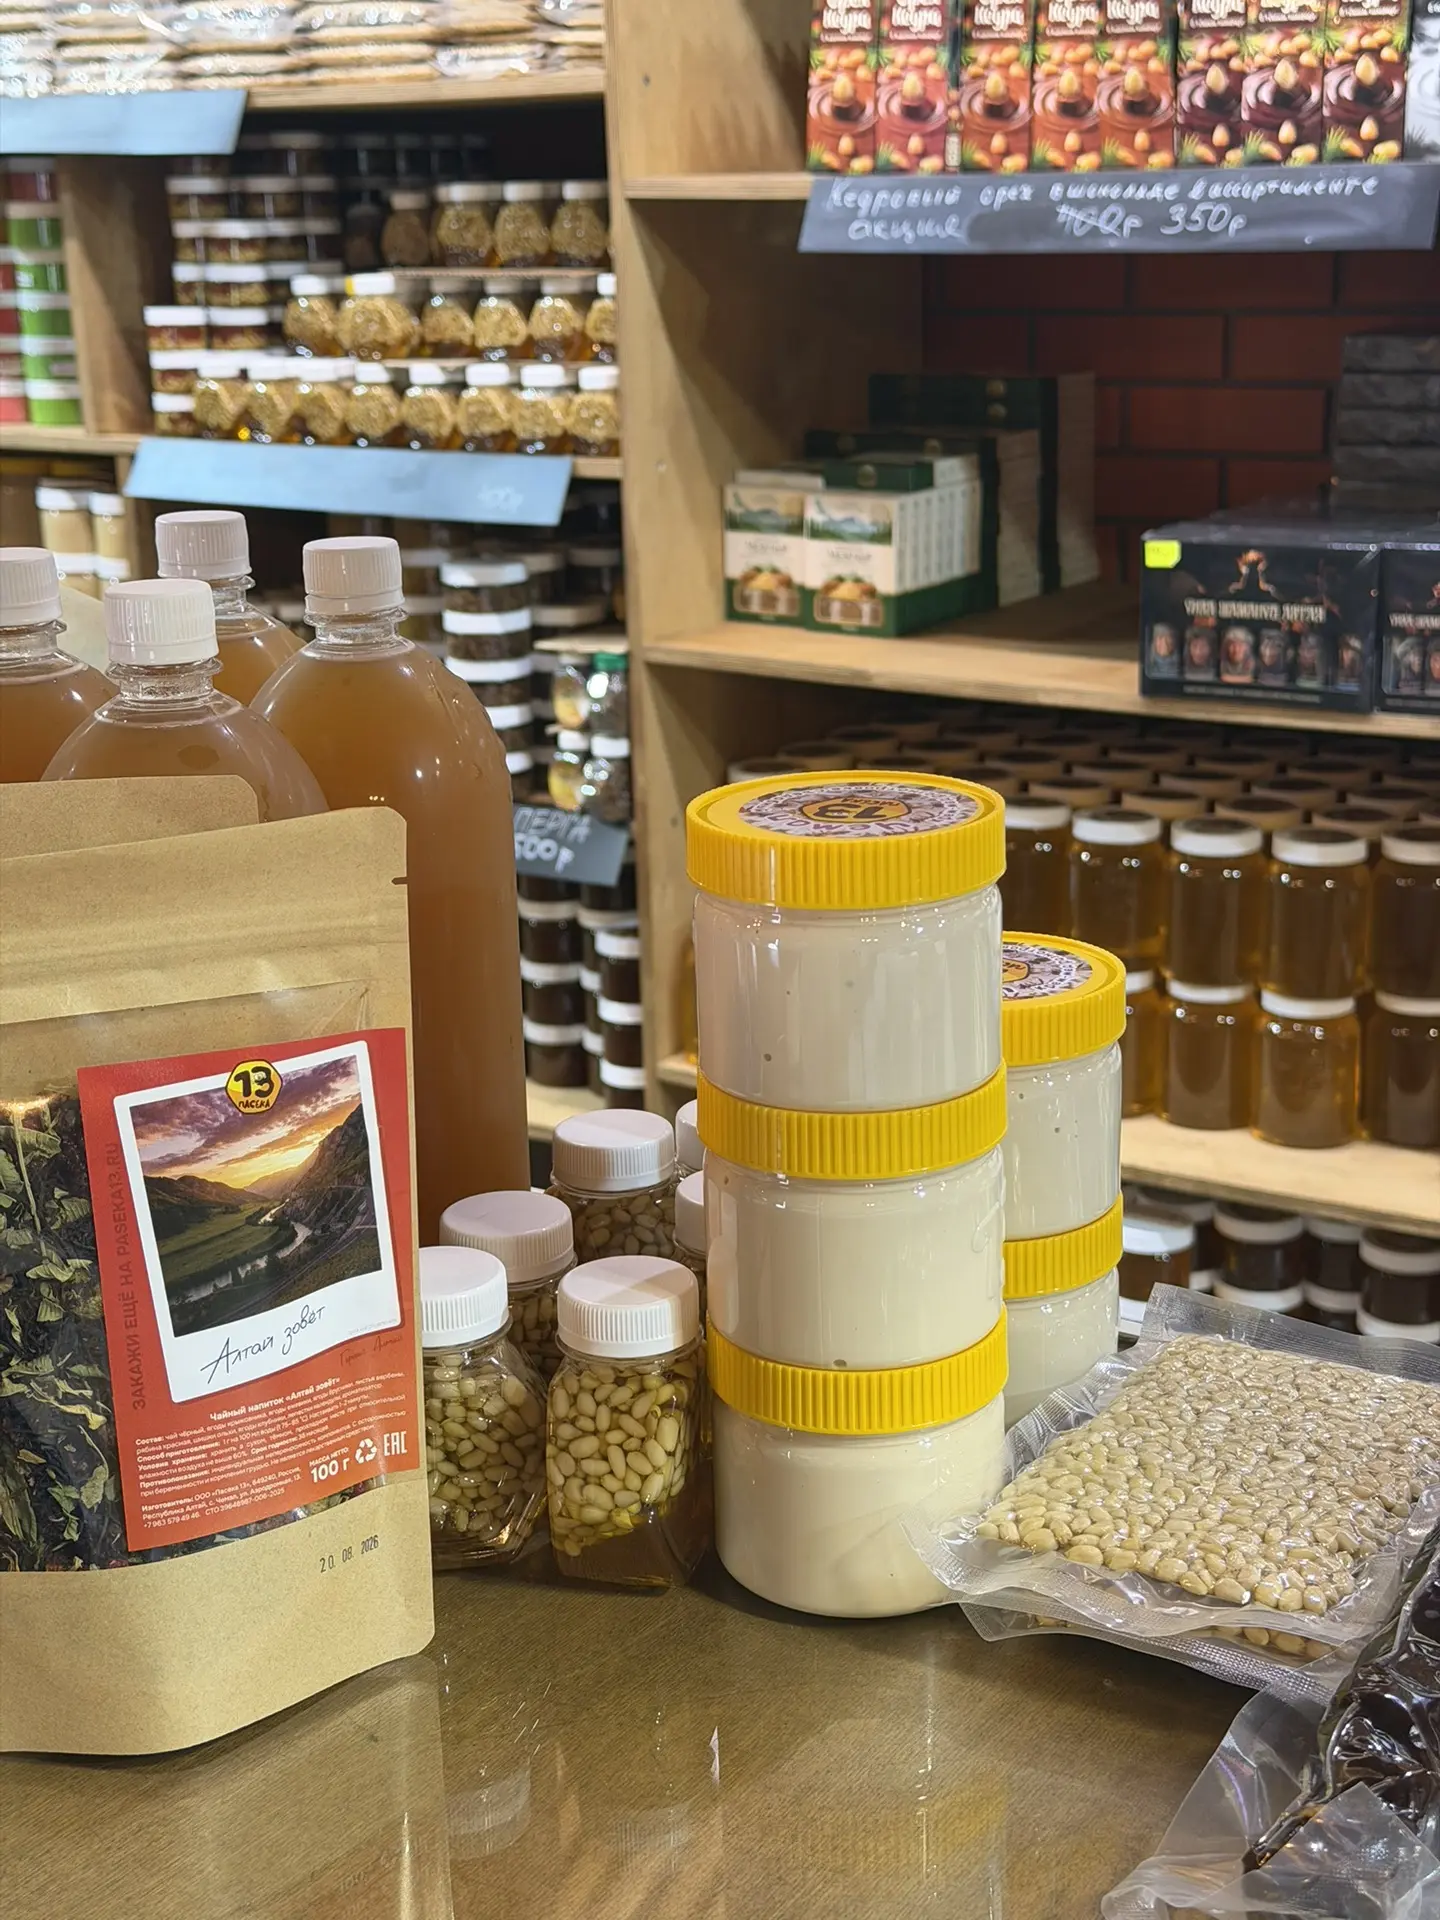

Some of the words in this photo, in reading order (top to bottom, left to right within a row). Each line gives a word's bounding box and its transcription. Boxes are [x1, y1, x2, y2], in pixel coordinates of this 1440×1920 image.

[980, 184, 1035, 211] орех
[812, 804, 887, 819] 13
[234, 1066, 274, 1097] 13
[238, 1099, 270, 1109] ПАСЕКА
[106, 1142, 130, 1253] PASEKA13.RU
[119, 1260, 132, 1286] НА
[119, 1292, 139, 1331] ЕЩЁ
[200, 1336, 275, 1384] Алтай
[126, 1333, 146, 1411] ЗАКАЖИ
[209, 1405, 246, 1421] Чайный
[247, 1396, 284, 1412] напиток
[285, 1385, 314, 1400] «Алтай
[135, 1436, 164, 1445] Состав:
[136, 1445, 162, 1455] рябина
[136, 1451, 164, 1462] Способ
[137, 1461, 168, 1471] Условия
[171, 1453, 207, 1465] хранения:
[138, 1468, 177, 1479] влажности
[177, 1462, 205, 1472] воздуха
[311, 1460, 338, 1483] 100
[342, 1457, 350, 1471] г
[141, 1497, 193, 1512] Изготовитель:
[194, 1491, 210, 1500] ООО
[142, 1508, 184, 1520] Республика
[185, 1502, 207, 1511] Алтай,
[360, 1534, 379, 1555] 2026
